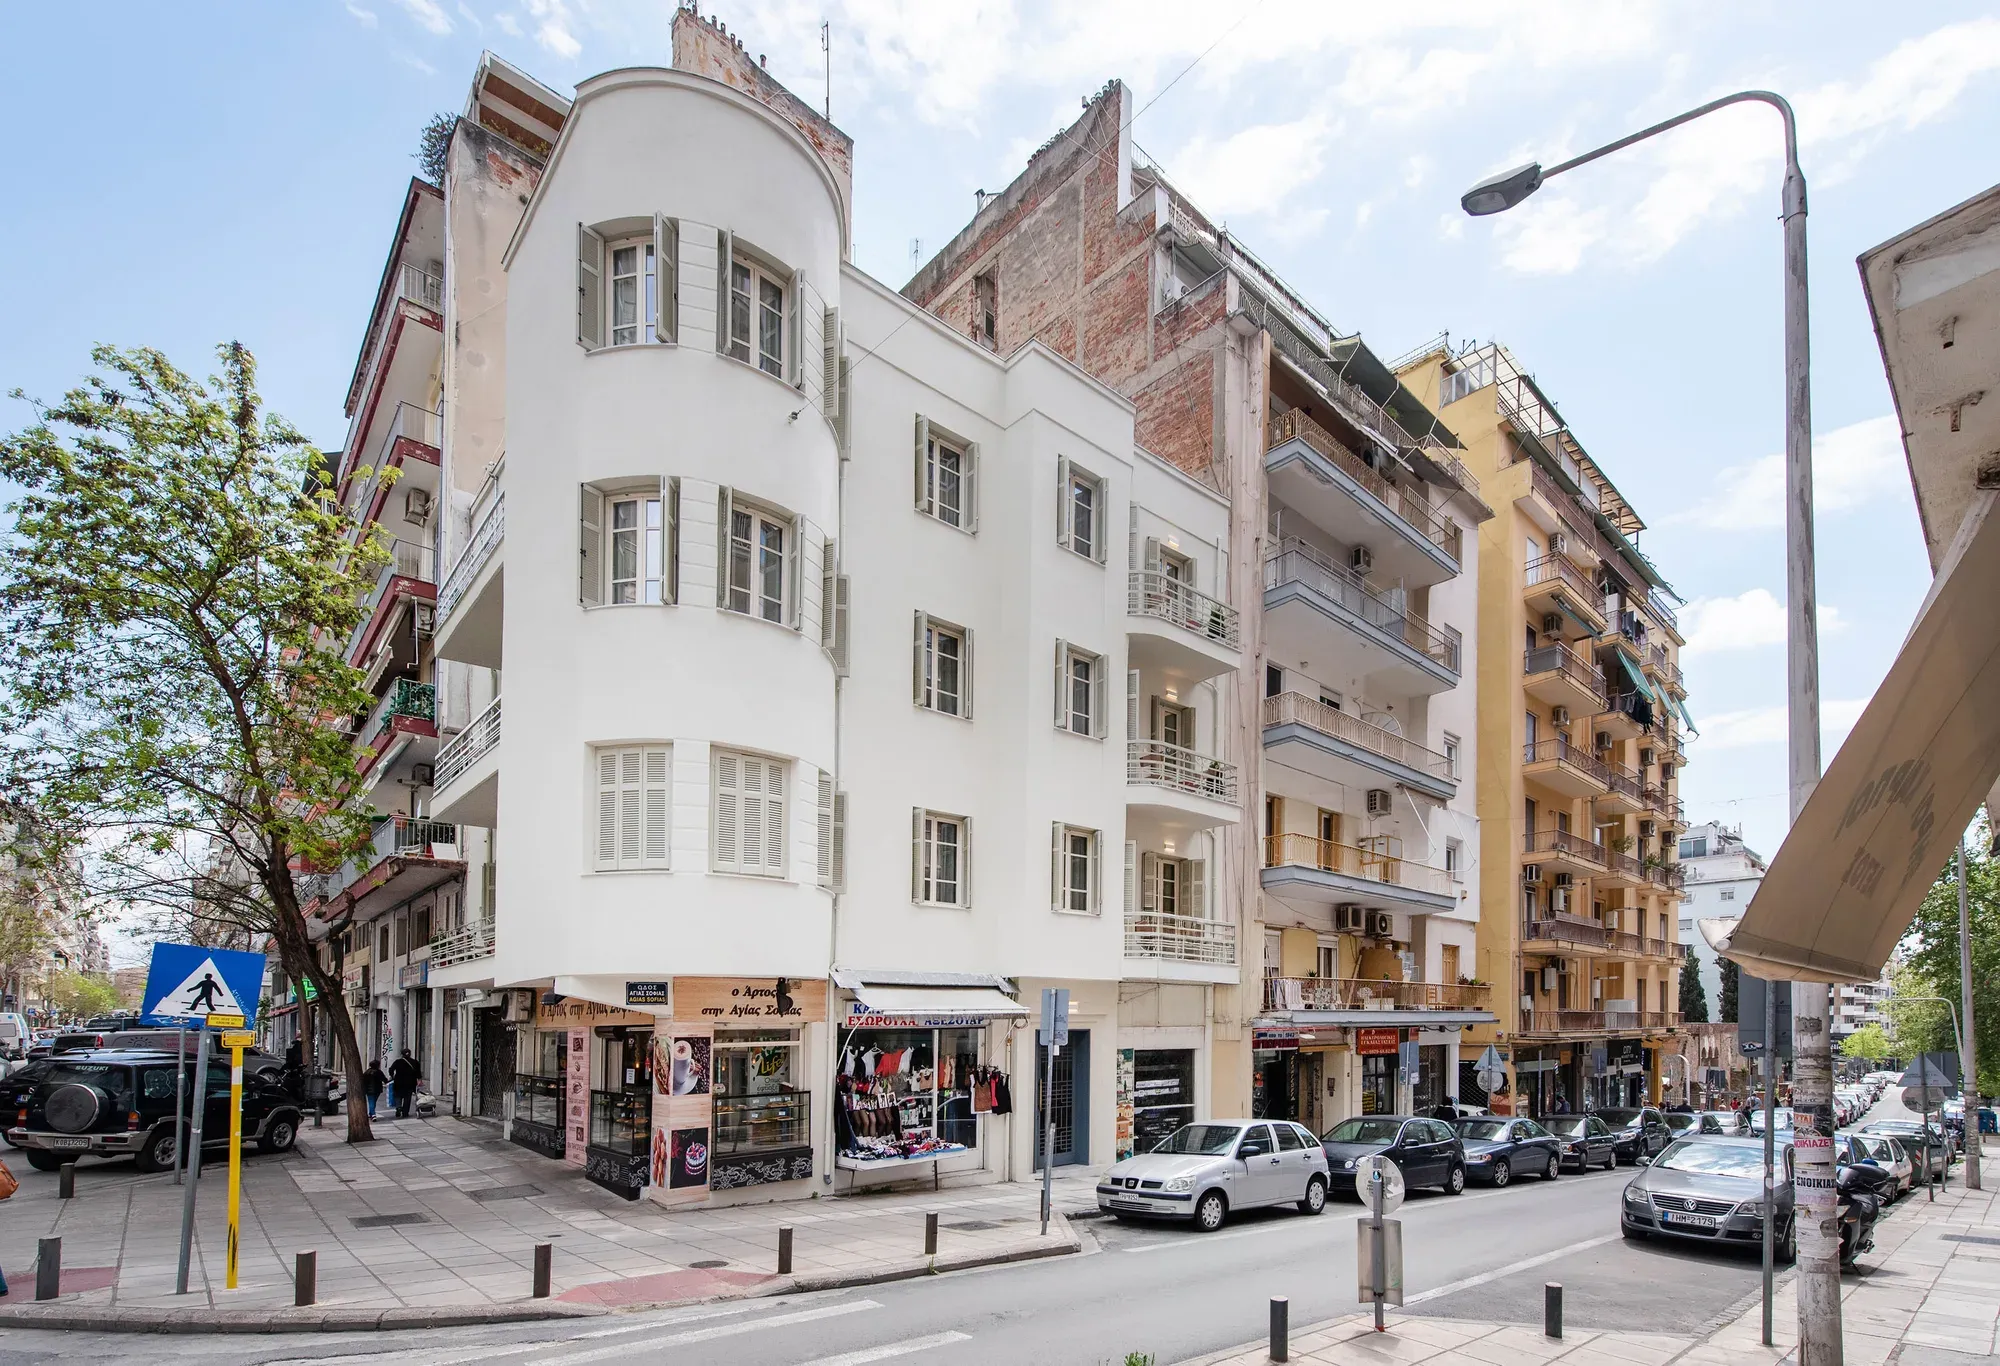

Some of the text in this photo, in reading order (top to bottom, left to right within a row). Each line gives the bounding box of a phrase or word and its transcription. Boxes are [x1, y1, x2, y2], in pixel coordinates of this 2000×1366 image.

[743, 985, 776, 999] Άρτος
[702, 1007, 724, 1017] στην
[729, 1004, 761, 1017] Αγίας
